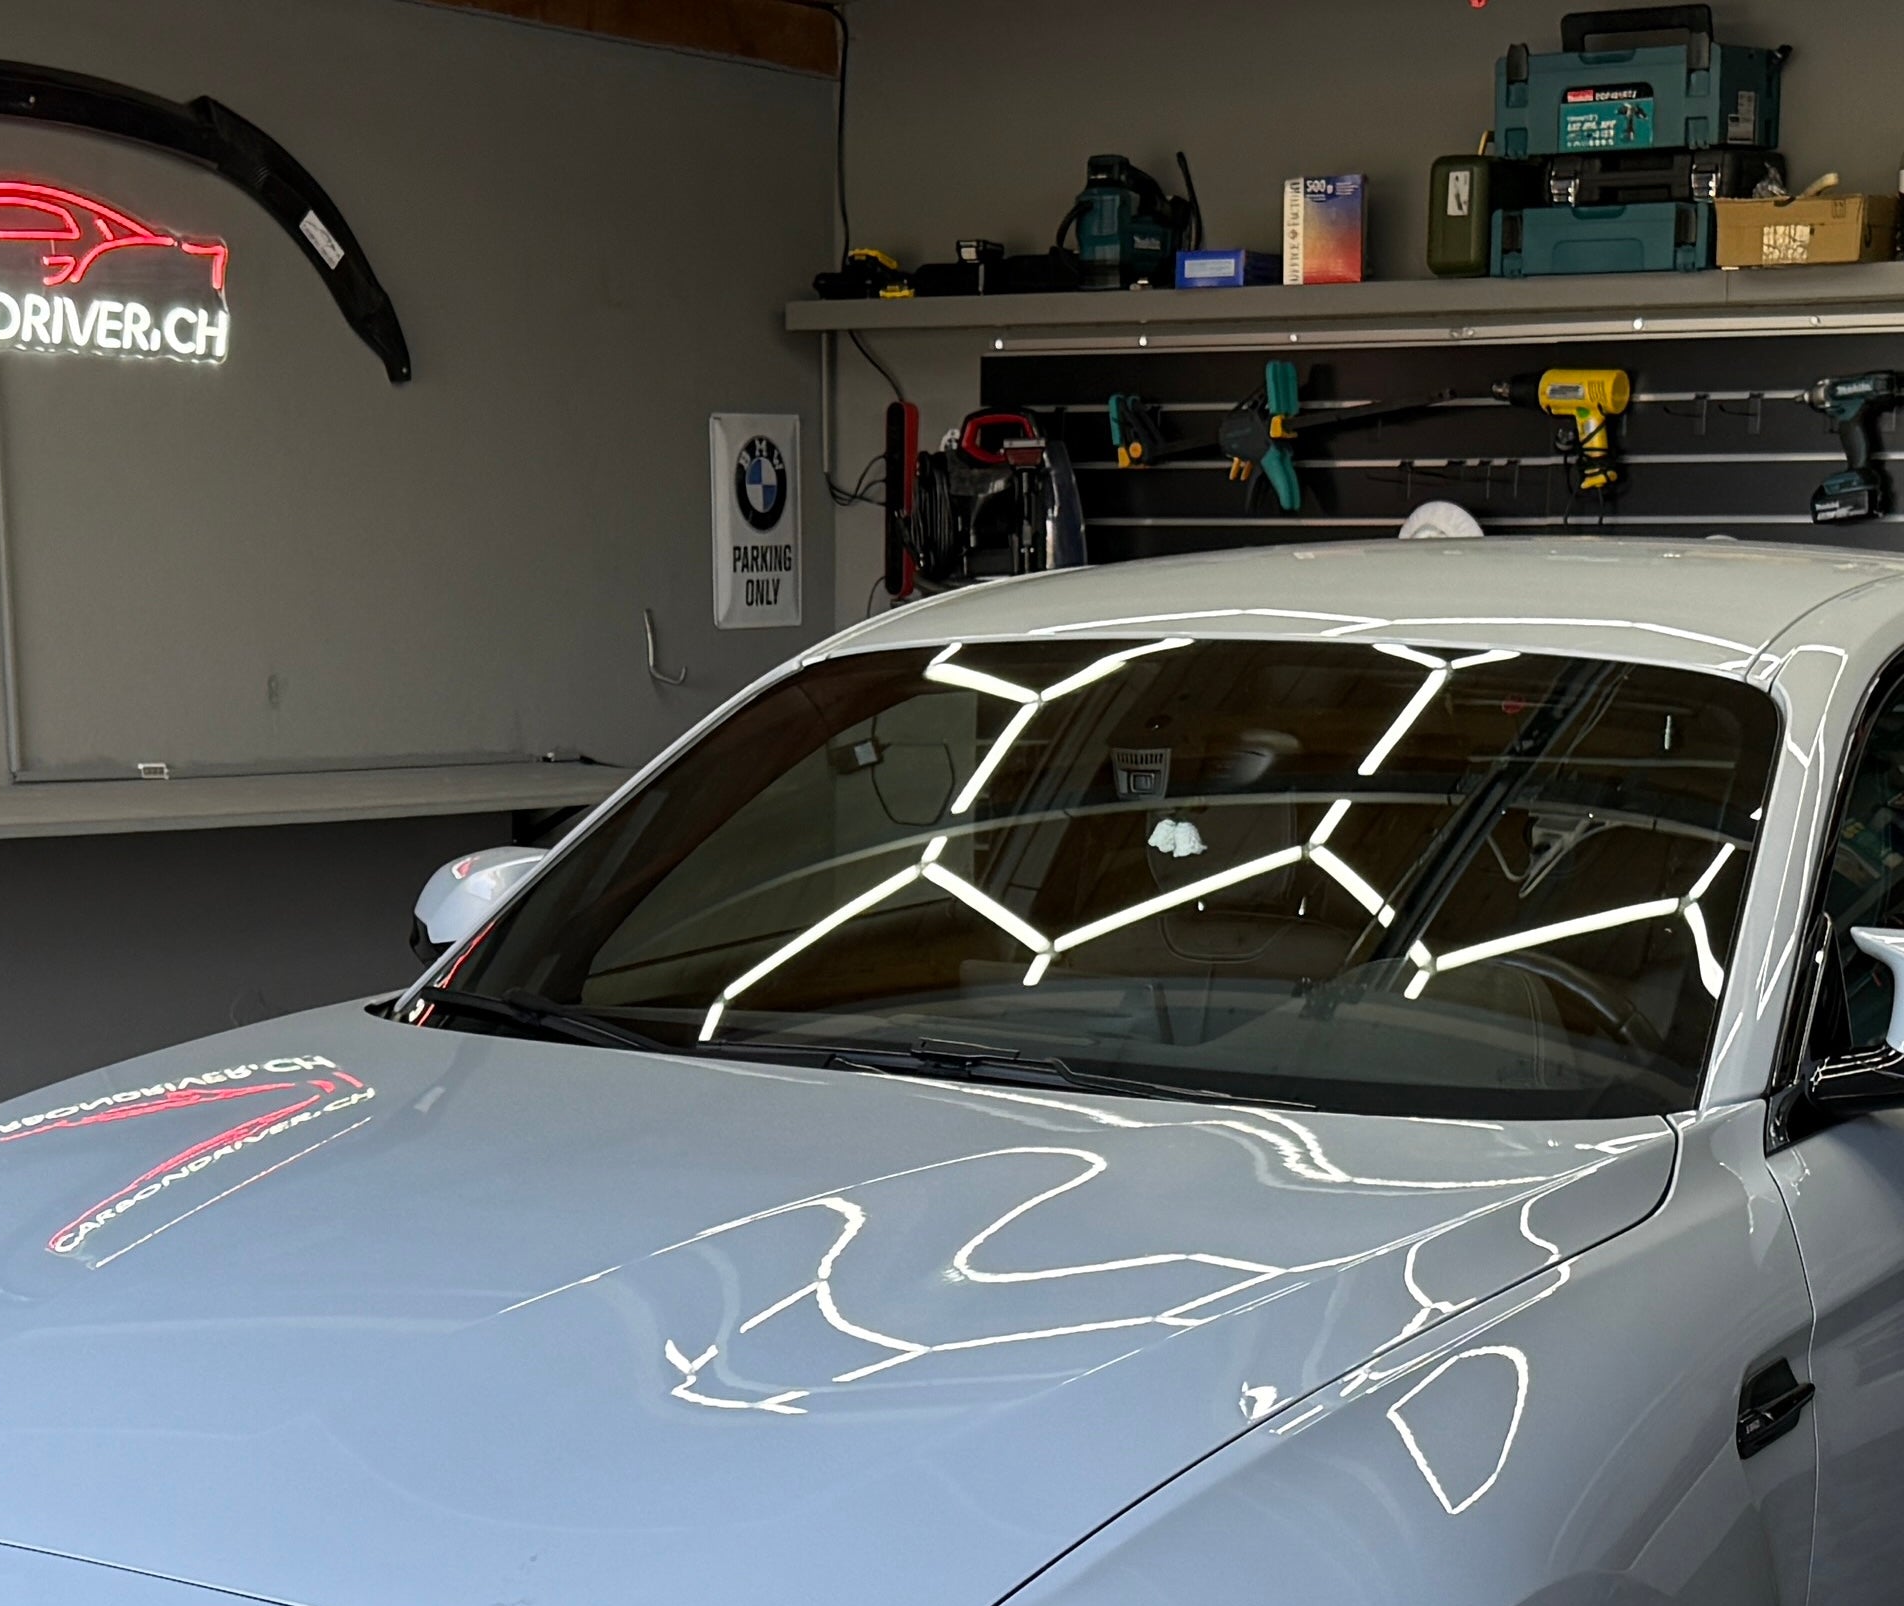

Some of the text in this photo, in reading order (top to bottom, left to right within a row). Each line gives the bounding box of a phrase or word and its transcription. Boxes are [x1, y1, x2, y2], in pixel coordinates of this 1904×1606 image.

[738, 438, 786, 471] BMW
[733, 545, 792, 573] PARKING
[745, 578, 781, 606] ONLY
